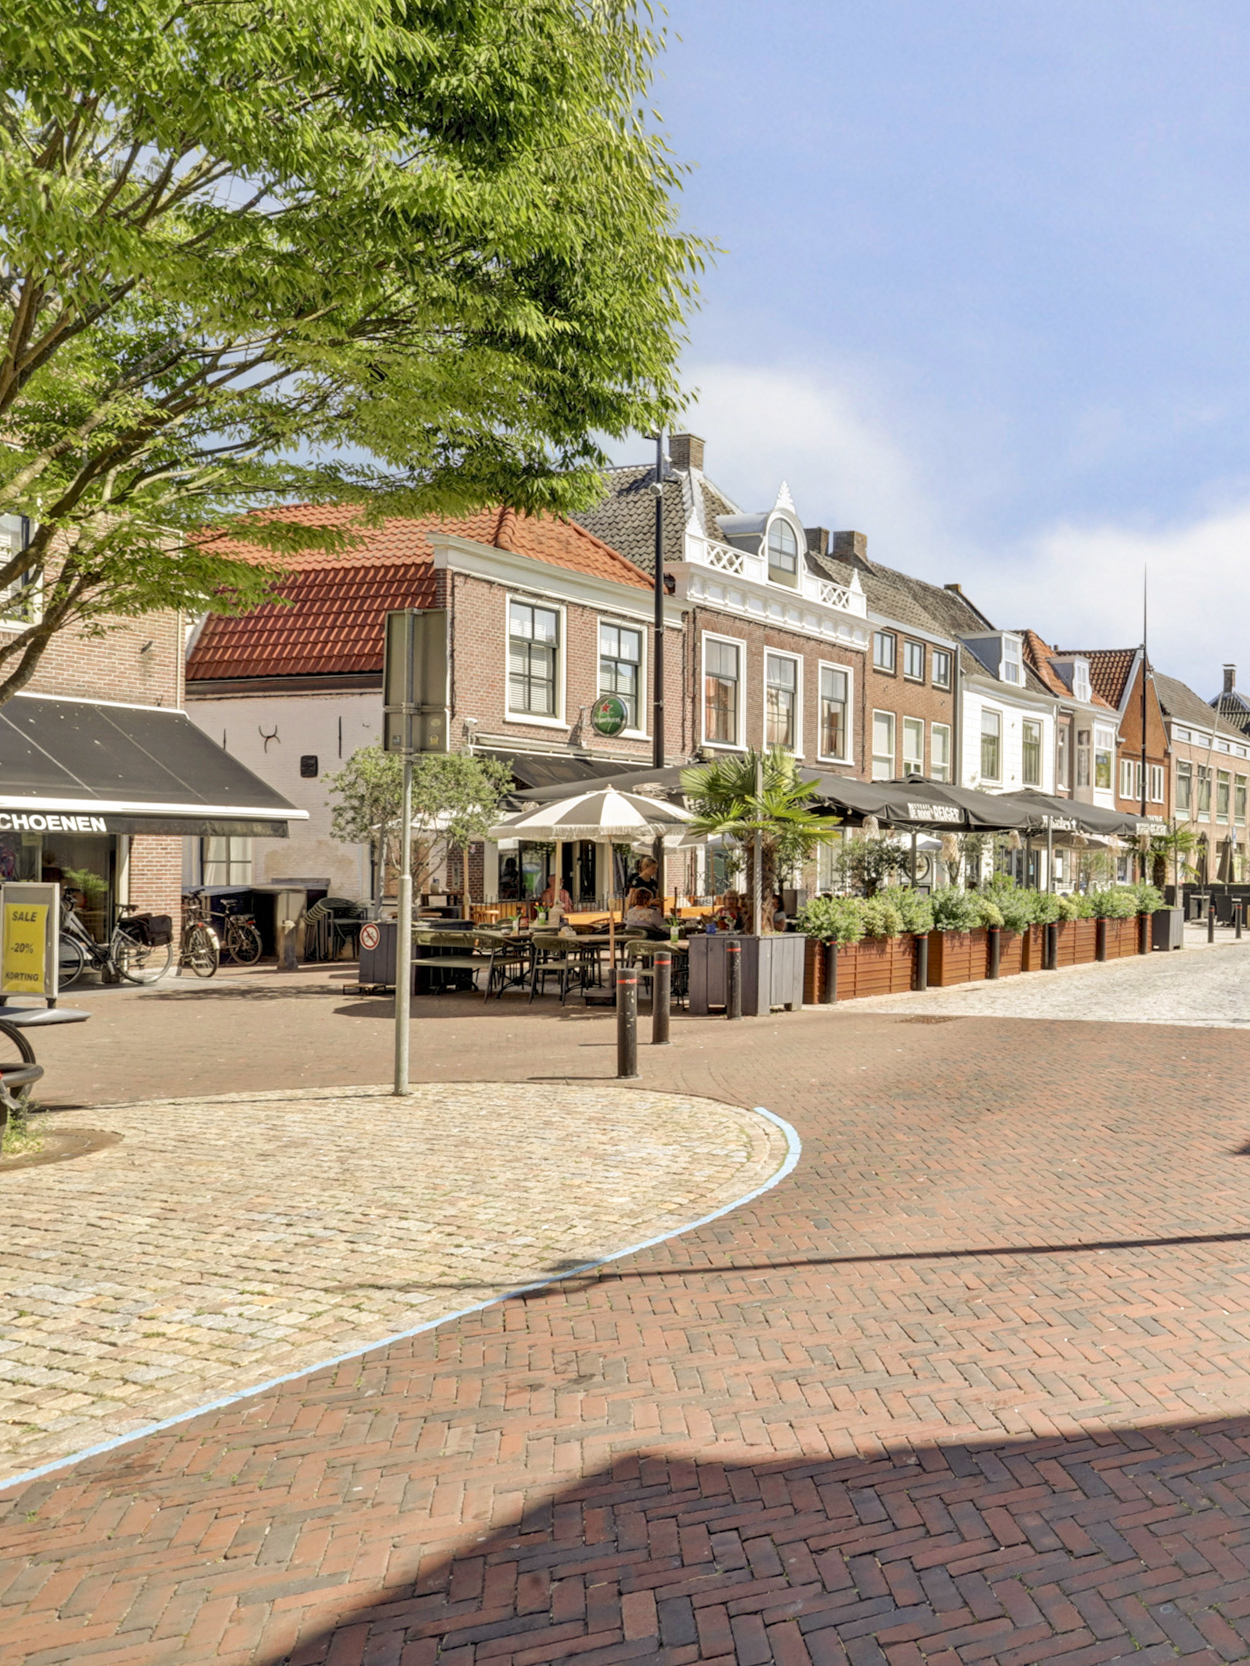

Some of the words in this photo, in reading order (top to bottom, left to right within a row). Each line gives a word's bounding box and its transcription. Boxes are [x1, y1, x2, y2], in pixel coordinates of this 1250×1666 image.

[12, 911, 38, 922] SALE
[11, 942, 34, 954] -20%
[5, 971, 39, 982] KORTING
